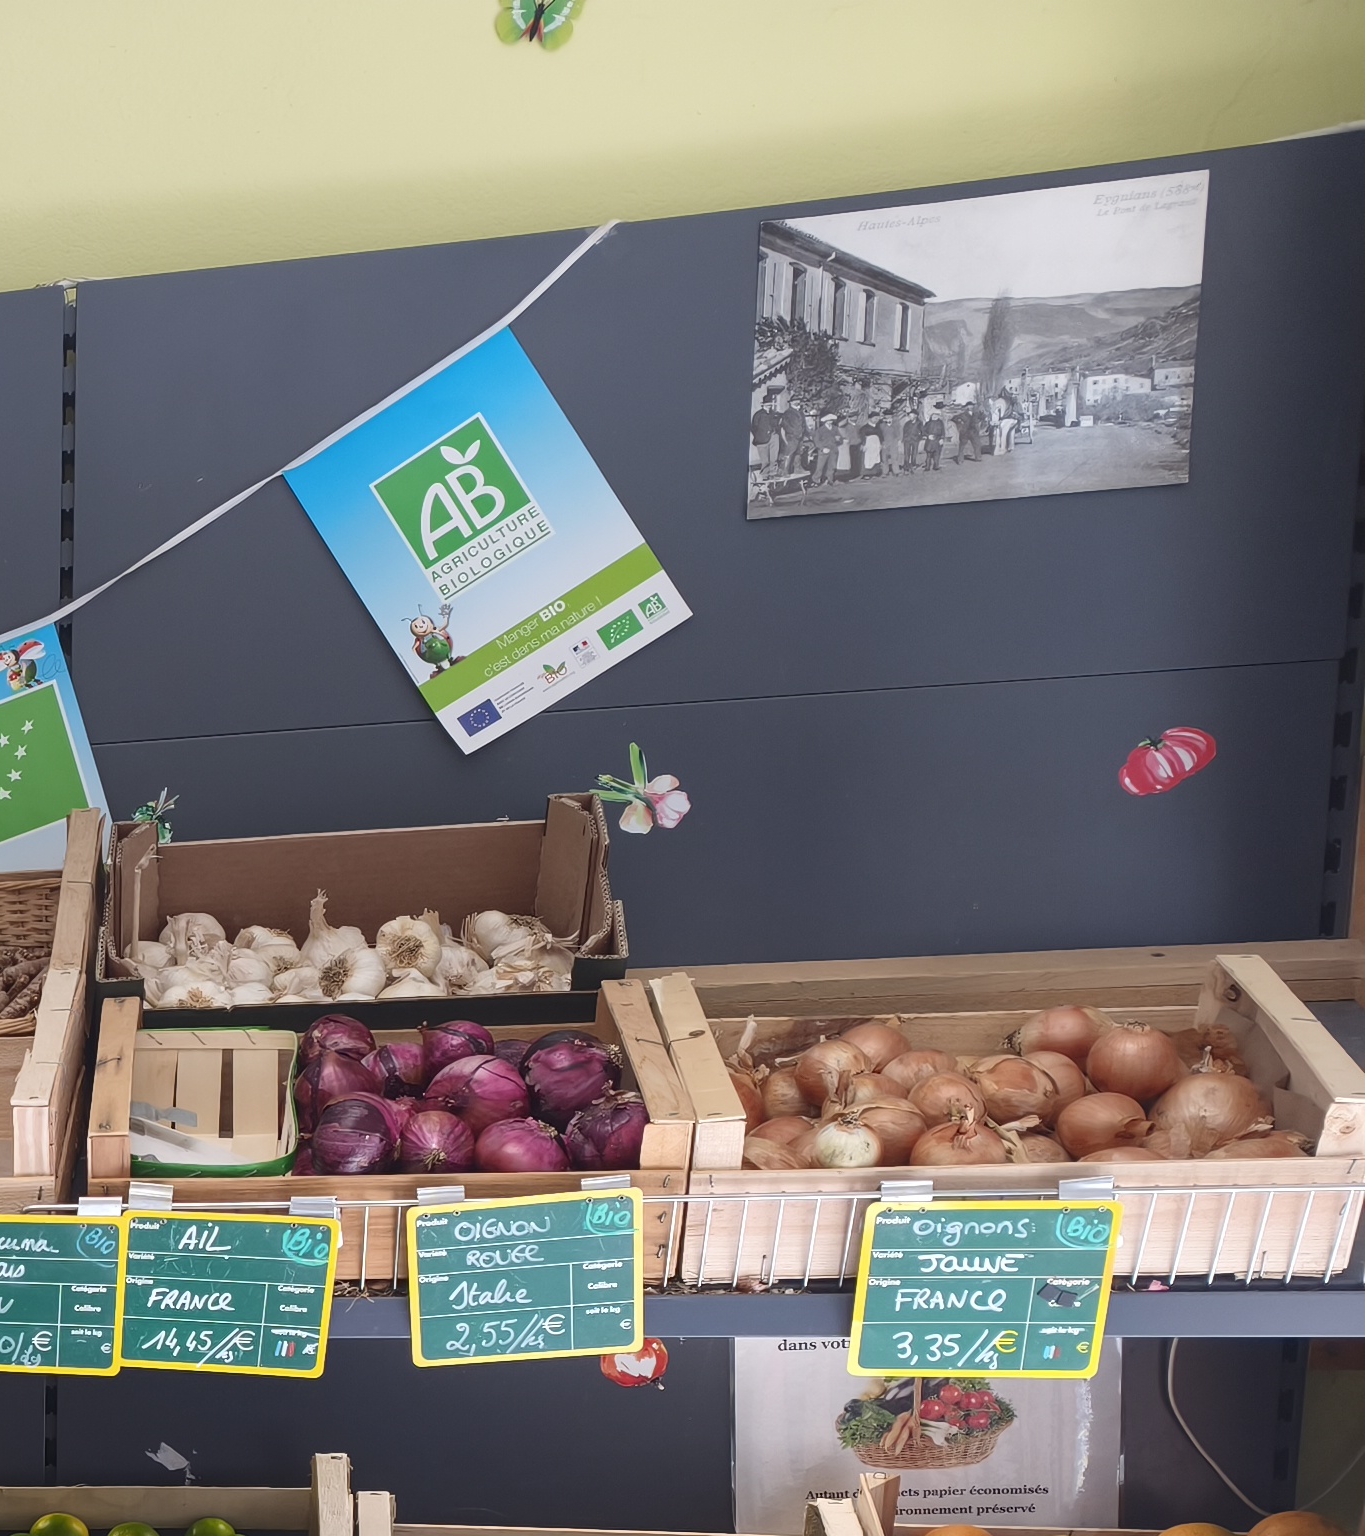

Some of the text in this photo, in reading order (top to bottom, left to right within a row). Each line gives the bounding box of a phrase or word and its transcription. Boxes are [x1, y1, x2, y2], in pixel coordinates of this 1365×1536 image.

[420, 464, 507, 561] AB
[430, 505, 542, 585] AGRICULTURE
[439, 519, 553, 599] BIOLOGIQUE
[483, 606, 597, 678] c'est dans ma nature
[495, 616, 540, 653] Manger
[416, 1216, 551, 1243] Produit OIGNON
[875, 1216, 1030, 1247] Produit Oignons
[917, 1253, 1027, 1274] JAUNE
[868, 1278, 902, 1287] Origine
[777, 1338, 818, 1353] dans
[923, 1486, 968, 1499] papier
[971, 1483, 1052, 1497] économisés
[978, 1503, 1038, 1517] préservé
